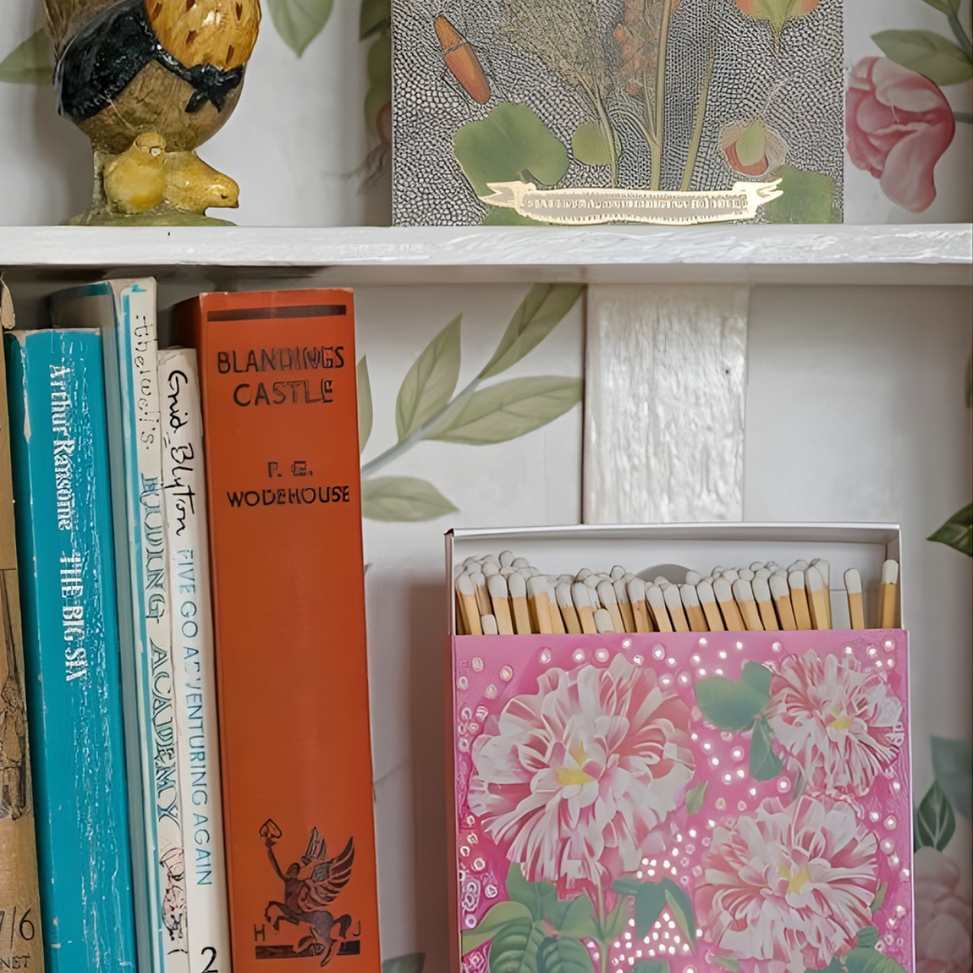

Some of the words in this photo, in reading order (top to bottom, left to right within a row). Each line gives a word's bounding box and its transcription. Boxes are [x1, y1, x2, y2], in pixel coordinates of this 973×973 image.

[217, 346, 345, 374] BLANDINGS
[49, 364, 71, 437] Arthur
[167, 370, 189, 434] Enid
[233, 379, 333, 407] CASTLE
[53, 438, 76, 531] Ransome
[163, 442, 195, 537] Blyton
[226, 485, 350, 508] WODEHOUSE
[60, 551, 84, 599] THE
[177, 549, 196, 594] FIVE
[62, 606, 85, 642] BIG
[180, 600, 199, 639] GO
[64, 647, 88, 682] SIX
[193, 813, 212, 886] AGAIN
